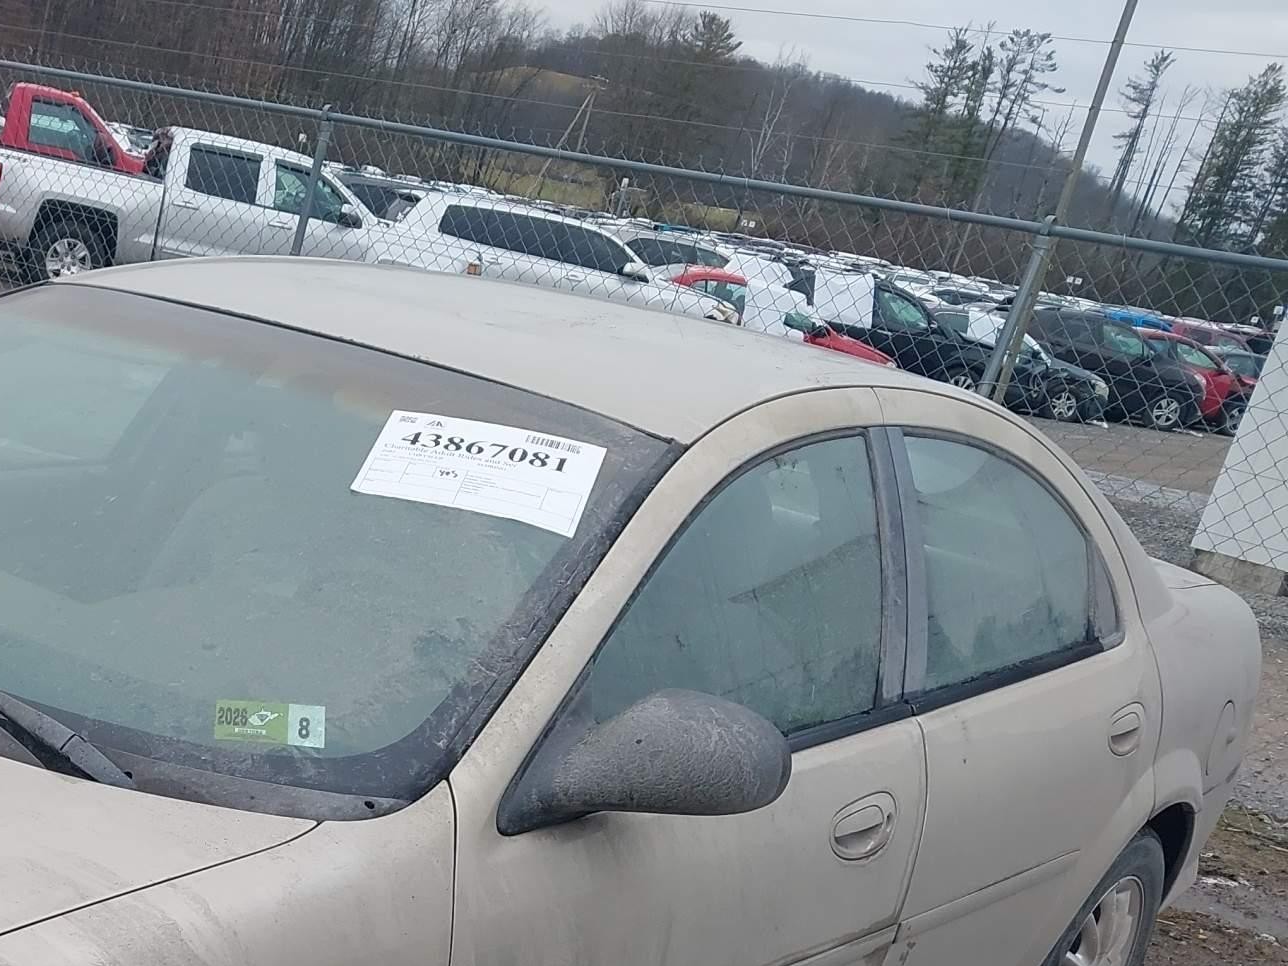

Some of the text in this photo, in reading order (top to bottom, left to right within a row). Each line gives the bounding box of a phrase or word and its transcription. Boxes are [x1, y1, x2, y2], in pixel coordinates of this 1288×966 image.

[384, 443, 427, 454] Charitable
[430, 448, 455, 457] Adult
[401, 431, 567, 473] 43867081
[217, 707, 248, 726] 2026
[298, 717, 311, 739] 8
